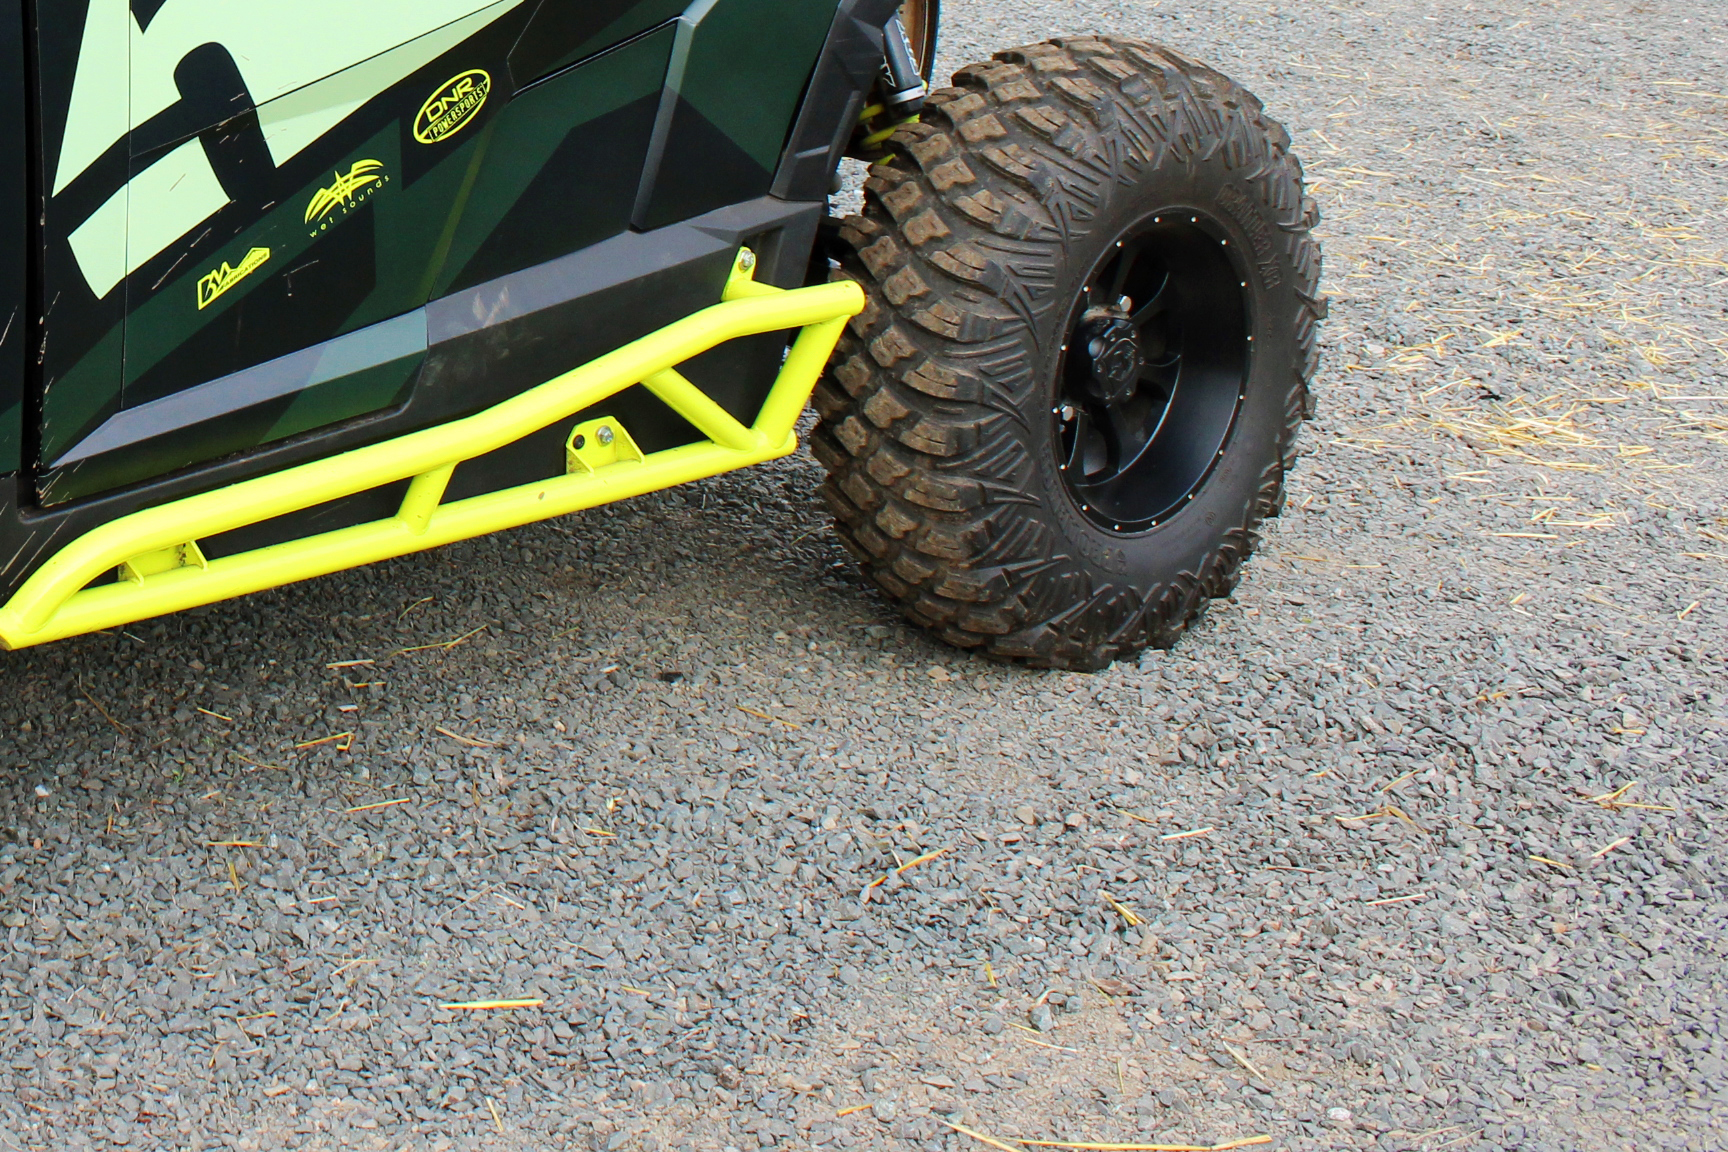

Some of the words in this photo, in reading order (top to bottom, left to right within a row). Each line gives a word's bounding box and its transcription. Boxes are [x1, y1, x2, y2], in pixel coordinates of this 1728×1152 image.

[425, 77, 474, 122] DNR
[432, 86, 484, 137] POWERSPORTS
[309, 216, 334, 238] wet
[342, 175, 389, 214] sounds
[220, 252, 268, 290] FABRICATIONS
